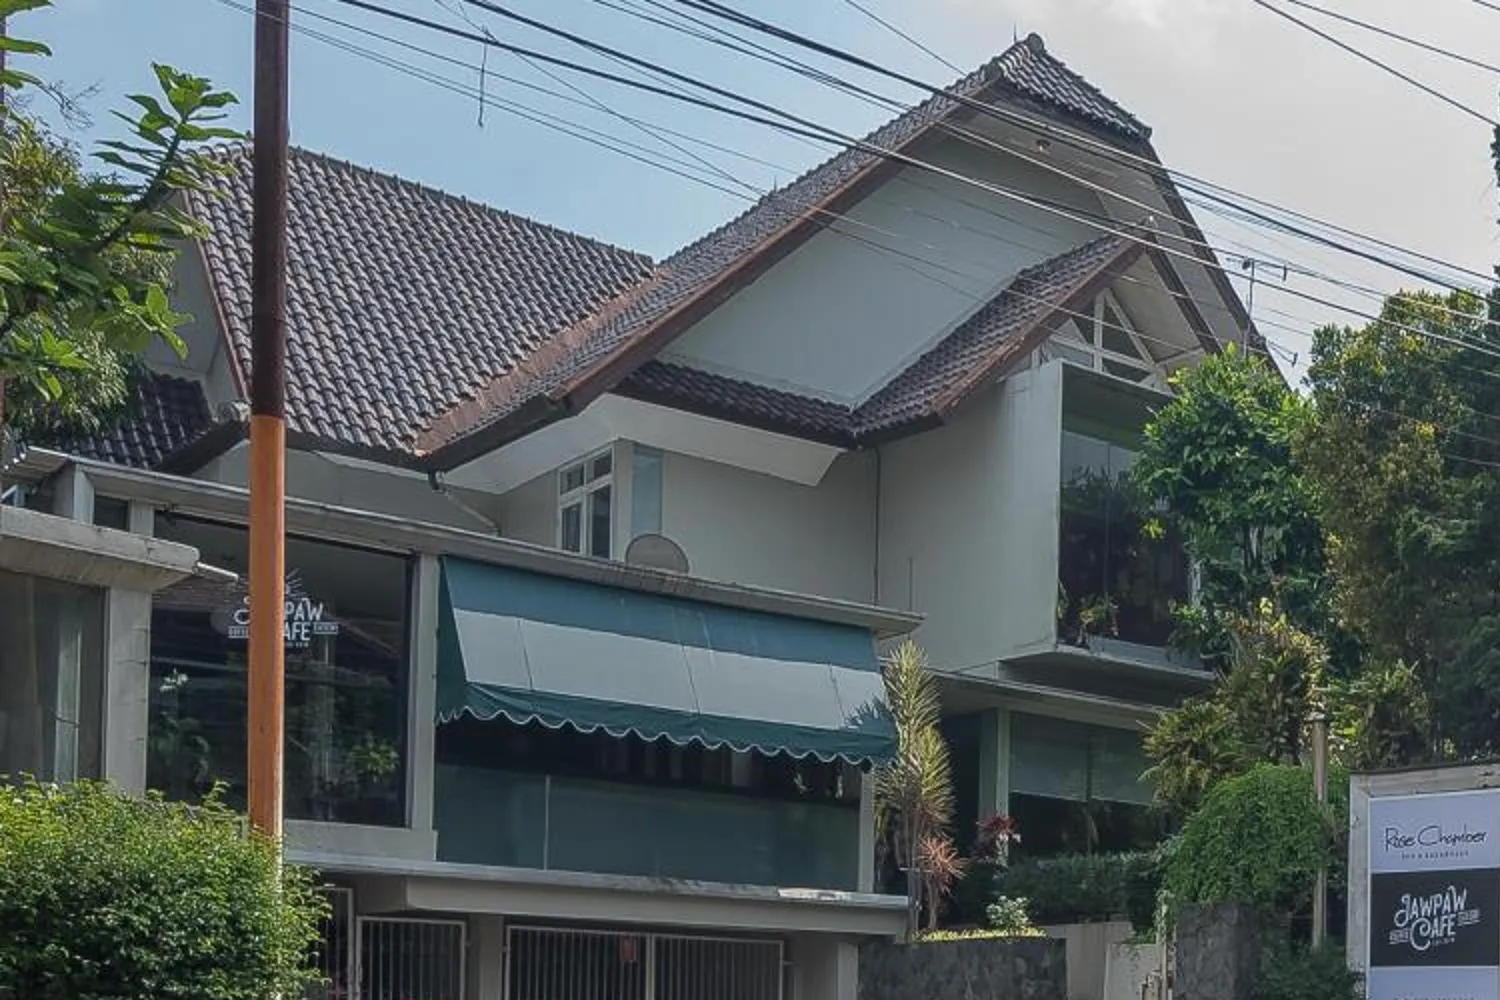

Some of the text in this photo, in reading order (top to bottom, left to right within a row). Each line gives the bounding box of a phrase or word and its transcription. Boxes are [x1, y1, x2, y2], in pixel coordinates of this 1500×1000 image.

[1417, 823, 1488, 847] Chamber
[1393, 884, 1468, 928] JAWPAW
[1410, 913, 1457, 951] CAFE
